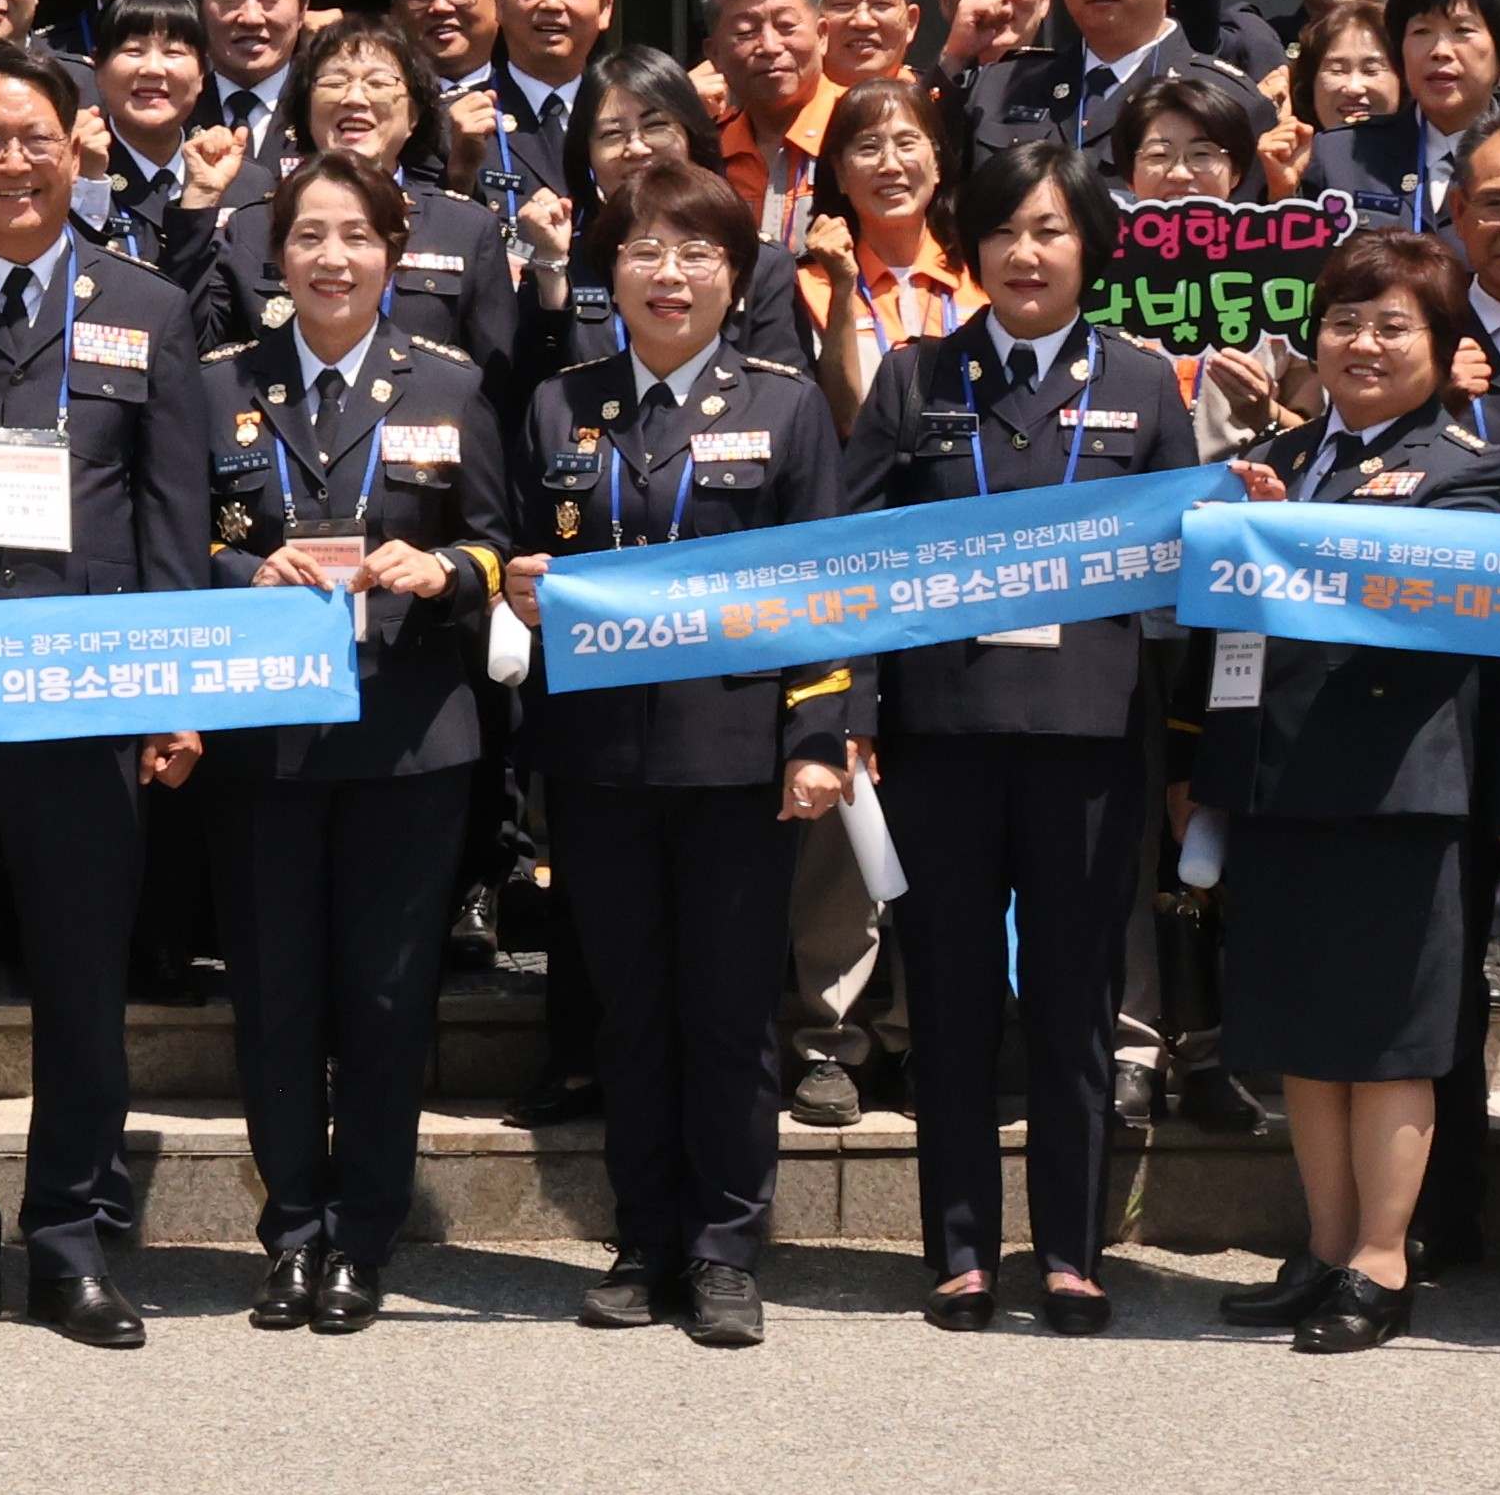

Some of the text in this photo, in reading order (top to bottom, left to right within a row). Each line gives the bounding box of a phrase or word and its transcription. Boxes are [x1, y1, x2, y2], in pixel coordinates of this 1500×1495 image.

[667, 573, 728, 599] 소통과
[738, 561, 818, 588] 화합으로
[827, 549, 909, 575] 이어가는
[1013, 516, 1119, 550] 안전지킴이
[1315, 537, 1381, 561] 소통과
[1391, 545, 1475, 569] 화합으로
[571, 540, 1181, 654] 2026년 광주-대구 의용소방대 교류행
[1209, 560, 1347, 605] 2026년
[128, 626, 231, 649] 안전지킴이
[3, 662, 179, 702] 의용소방대
[190, 654, 332, 693] 교류행사
